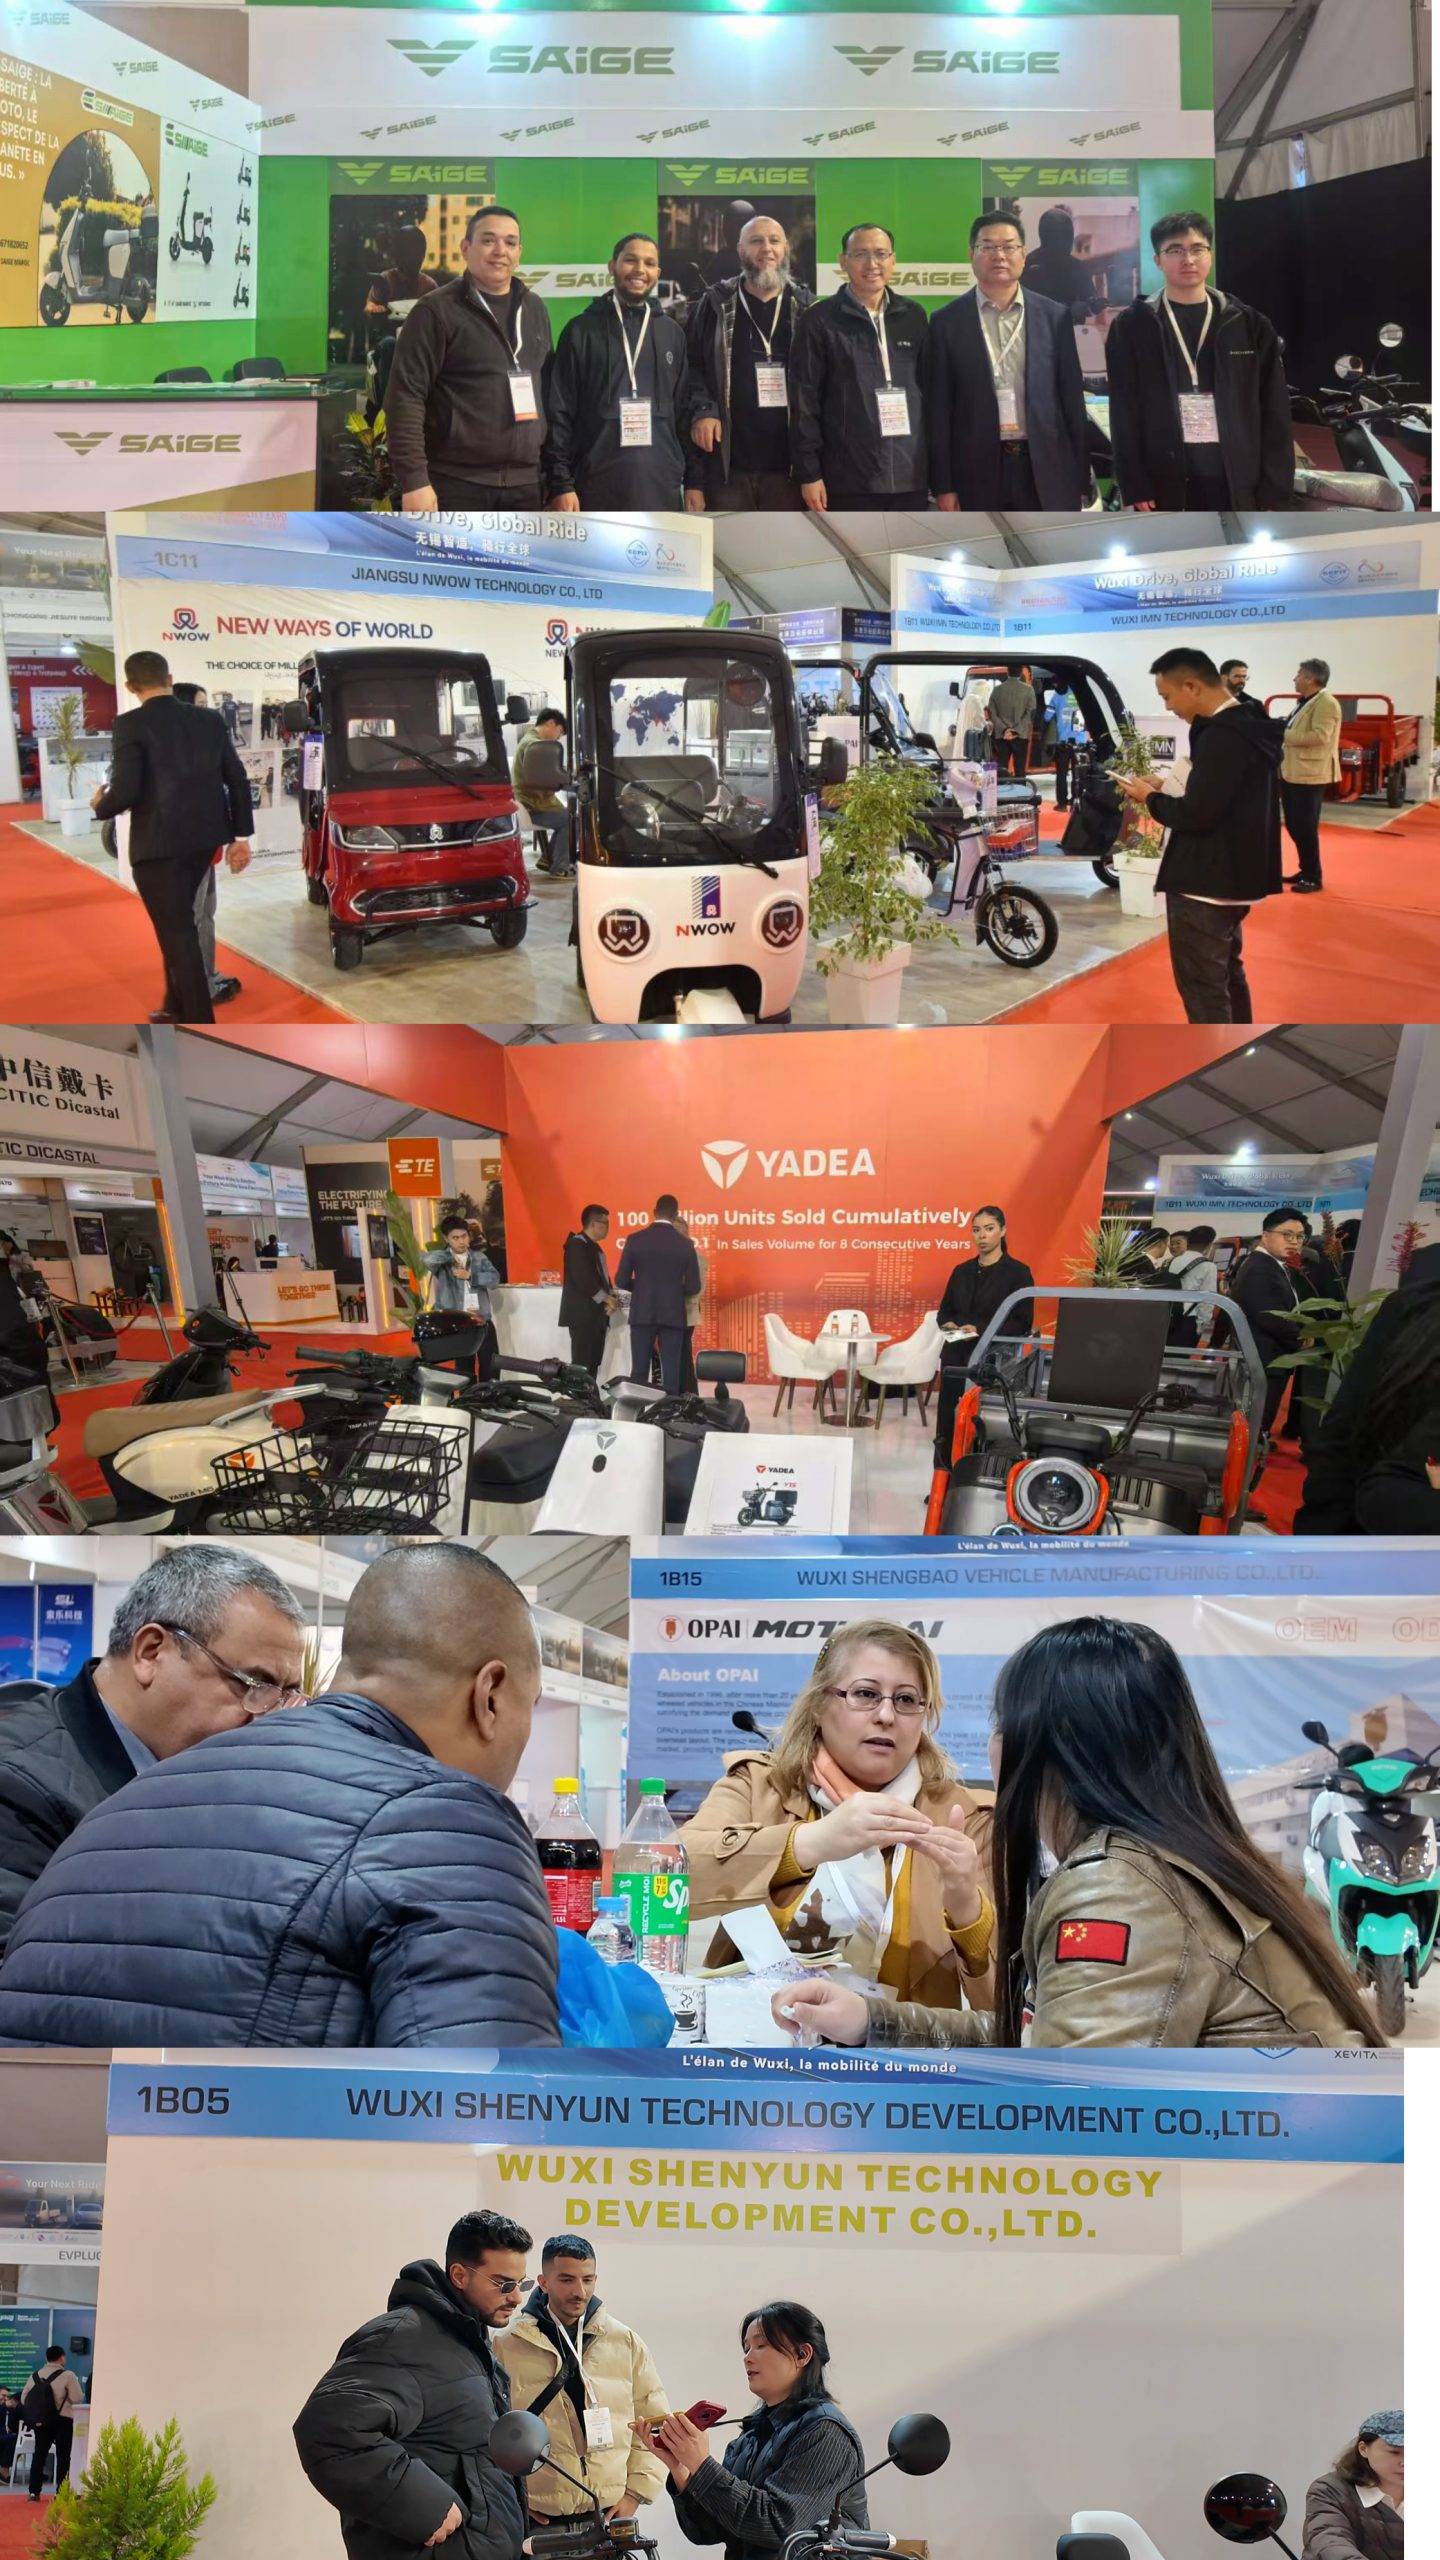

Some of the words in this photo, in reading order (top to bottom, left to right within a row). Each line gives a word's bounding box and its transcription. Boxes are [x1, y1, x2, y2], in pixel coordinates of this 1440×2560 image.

[40, 72, 52, 89] LA
[27, 110, 38, 124] LE
[35, 132, 46, 146] DE
[49, 135, 60, 151] LA
[33, 150, 45, 165] EN
[480, 514, 542, 536] Global
[549, 523, 588, 542] Ride
[154, 551, 199, 569] 1C11
[352, 567, 419, 585] JIANGSU
[422, 573, 471, 589] NWOW
[474, 577, 556, 597] TECHNOLOGY
[559, 585, 581, 600] CO.,
[584, 587, 603, 600] LTD
[1094, 574, 1131, 590] Wuxi
[1133, 571, 1179, 587] Drive,
[1183, 566, 1235, 583] Global
[1239, 562, 1279, 577] Ride
[1111, 615, 1139, 626] WUXI
[1140, 614, 1161, 624] IMN
[1164, 608, 1238, 622] TECHNOLOGY
[1240, 605, 1286, 618] CO.,LTD
[162, 632, 210, 641] NWOW
[217, 616, 270, 636] NEW
[273, 619, 332, 637] WAYS
[335, 621, 362, 638] OF
[366, 622, 433, 639] WORLD
[1013, 622, 1032, 632] 1B11
[206, 661, 225, 670] THE
[226, 661, 263, 670] CHOICE
[264, 661, 277, 670] OF
[676, 921, 736, 937] NWOW
[55, 1096, 120, 1120] Dicastal
[26, 1144, 100, 1165] DICASTAL
[755, 1148, 876, 1178] YADEA
[415, 1158, 436, 1173] TE
[320, 1200, 340, 1210] THE
[342, 1200, 383, 1210] FUTURE
[1185, 1201, 1207, 1209] WUXI
[1227, 1201, 1280, 1209] TECHNOLOGY
[617, 1211, 649, 1226] 100
[724, 1208, 776, 1226] Units
[781, 1208, 826, 1225] Sold
[831, 1207, 972, 1228] Cumulatively
[717, 1239, 729, 1249] In
[731, 1239, 764, 1250] Sales
[767, 1238, 815, 1250] Volume
[818, 1238, 836, 1249] for
[840, 1239, 848, 1249] 8
[851, 1238, 931, 1250] Consecutive
[935, 1238, 971, 1250] Years
[768, 1466, 795, 1475] YADEA
[958, 1541, 985, 1551] L'élan
[986, 1541, 999, 1550] de
[1001, 1541, 1027, 1551] Wuxi,
[1029, 1540, 1039, 1549] la
[659, 1571, 702, 1587] 1B15
[797, 1570, 847, 1586] WUXI
[852, 1568, 959, 1585] SHENGBAO
[965, 1567, 1045, 1584] VEHICLE
[1050, 1564, 1229, 1583] MANUFACTURING
[688, 1619, 741, 1639] OPAI
[1275, 1616, 1358, 1643] OEM
[658, 1668, 711, 1682] About
[716, 1669, 759, 1682] OPAI
[641, 1894, 649, 1934] RECYCLE
[682, 2055, 727, 2069] L'élan
[730, 2055, 749, 2069] de
[753, 2057, 794, 2072] Wuxi,
[799, 2058, 813, 2071] la
[818, 2057, 880, 2073] mobilité
[884, 2059, 903, 2073] du
[908, 2061, 957, 2075] monde
[137, 2085, 231, 2115] 1B05
[346, 2088, 442, 2119] WUXI
[455, 2090, 630, 2124] SHENYUN
[641, 2097, 875, 2130] TECHNOLOGY
[885, 2102, 1144, 2136] DEVELOPMENT
[1154, 2108, 1291, 2141] CO.,LTD.
[25, 2178, 48, 2190] Your
[51, 2178, 75, 2190] Next
[497, 2153, 613, 2186] WUXI
[628, 2158, 843, 2192] SHENYUN
[858, 2164, 1163, 2199] TECHNOLOGY
[565, 2197, 896, 2234] DEVELOPMENT
[909, 2206, 1098, 2243] CO.,LTD.
